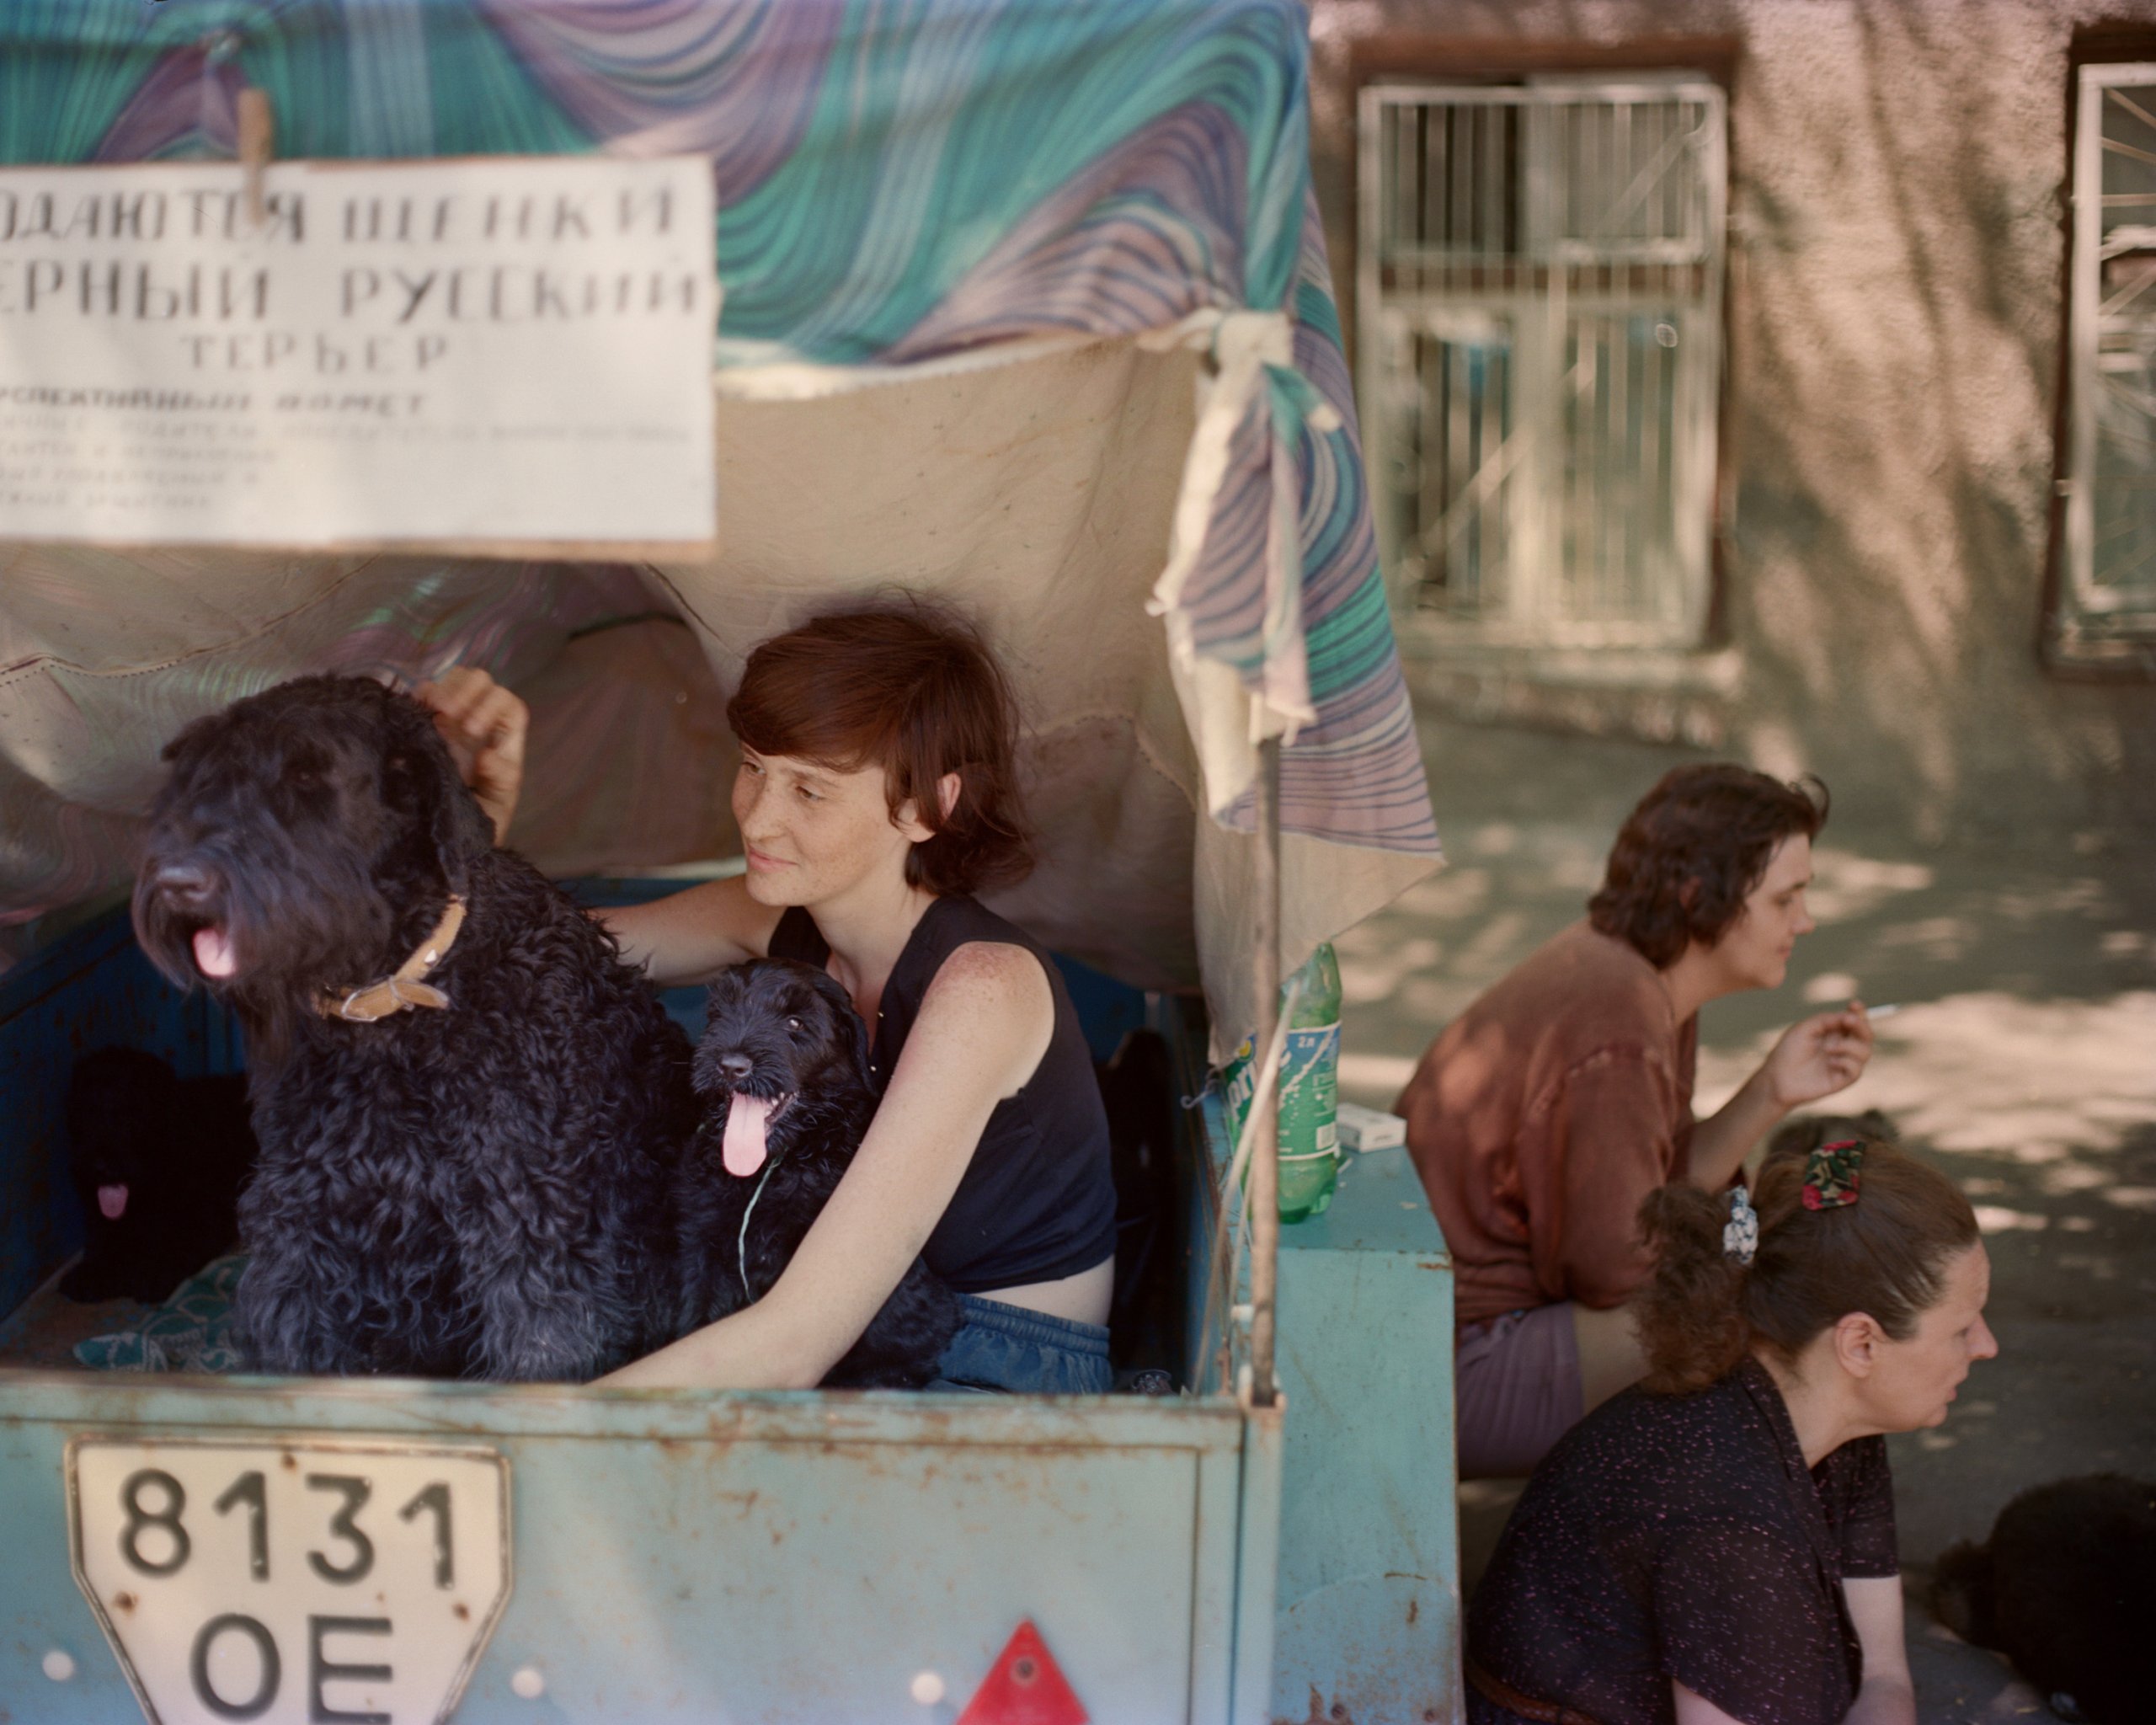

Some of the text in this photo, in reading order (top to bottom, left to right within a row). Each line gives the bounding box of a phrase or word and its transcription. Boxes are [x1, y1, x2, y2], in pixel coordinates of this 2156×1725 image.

[340, 255, 698, 323] РУССКИЙ
[178, 332, 449, 375] ТЕРЬЕР
[118, 1468, 456, 1590] 8131
[188, 1612, 393, 1725] ОЕ
